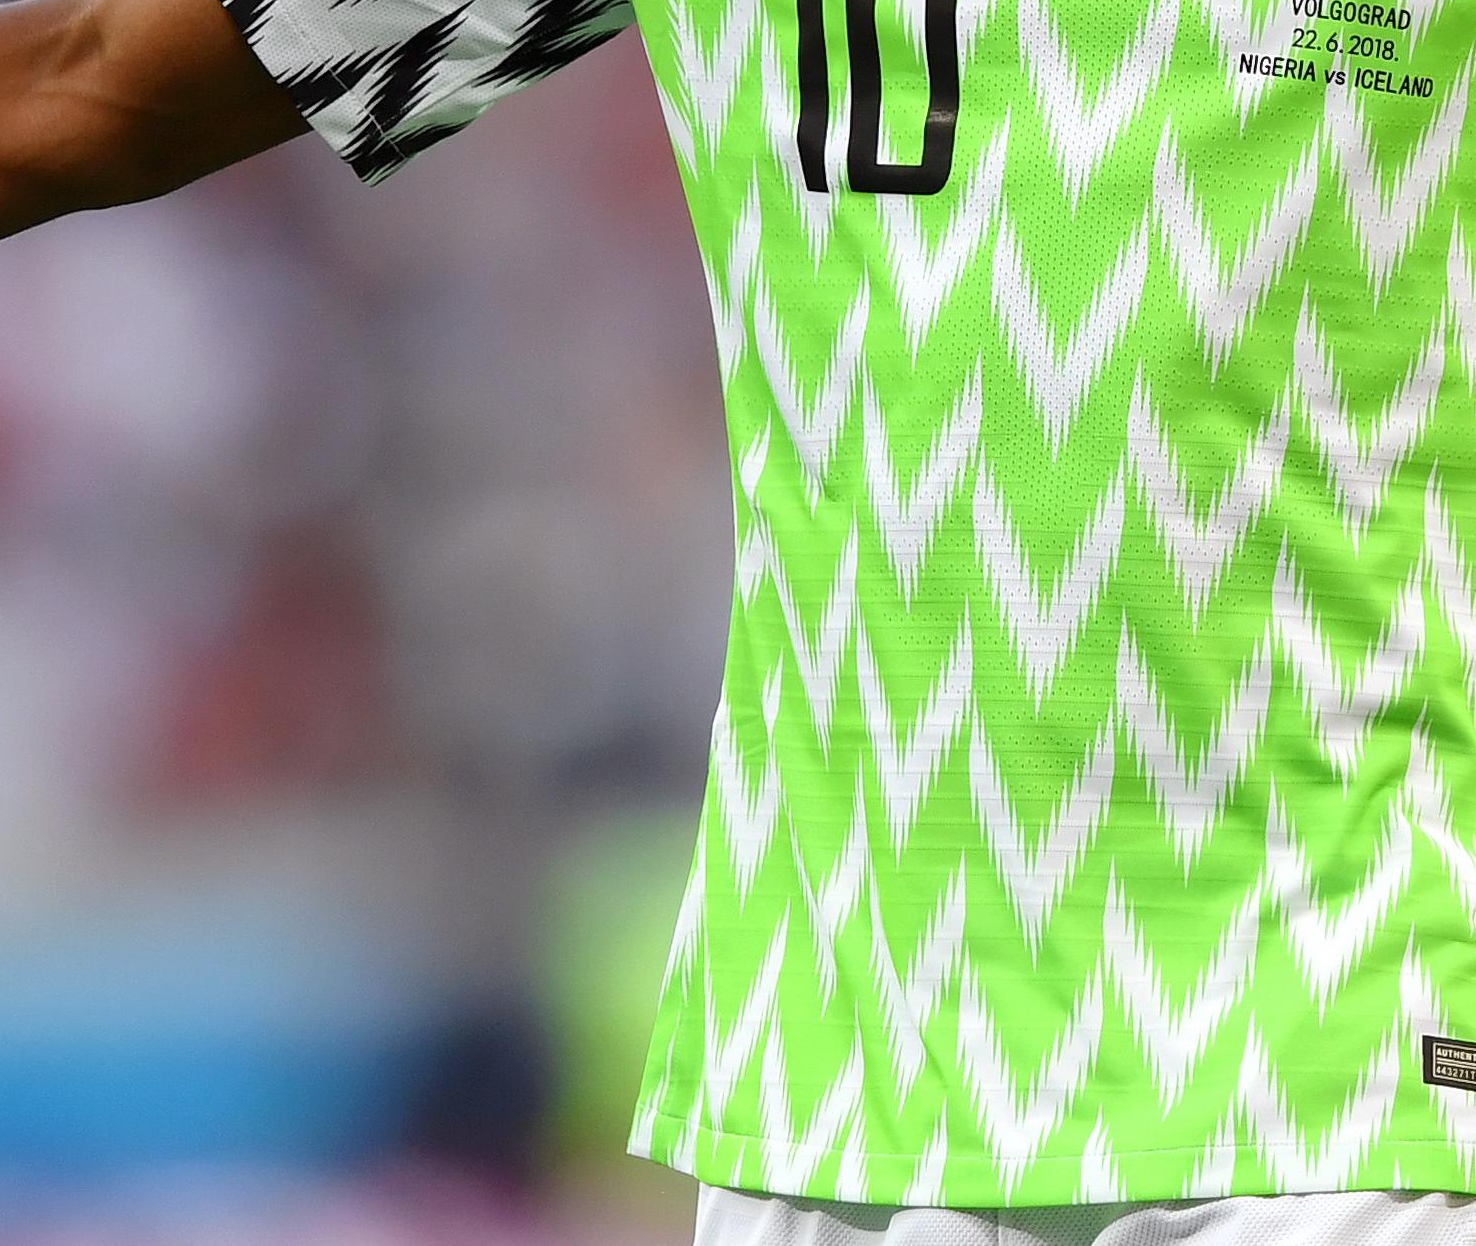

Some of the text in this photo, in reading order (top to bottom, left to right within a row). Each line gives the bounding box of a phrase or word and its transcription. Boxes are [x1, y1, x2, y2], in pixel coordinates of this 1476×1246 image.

[1239, 53, 1434, 98] NIGERIA vs ICELAND
